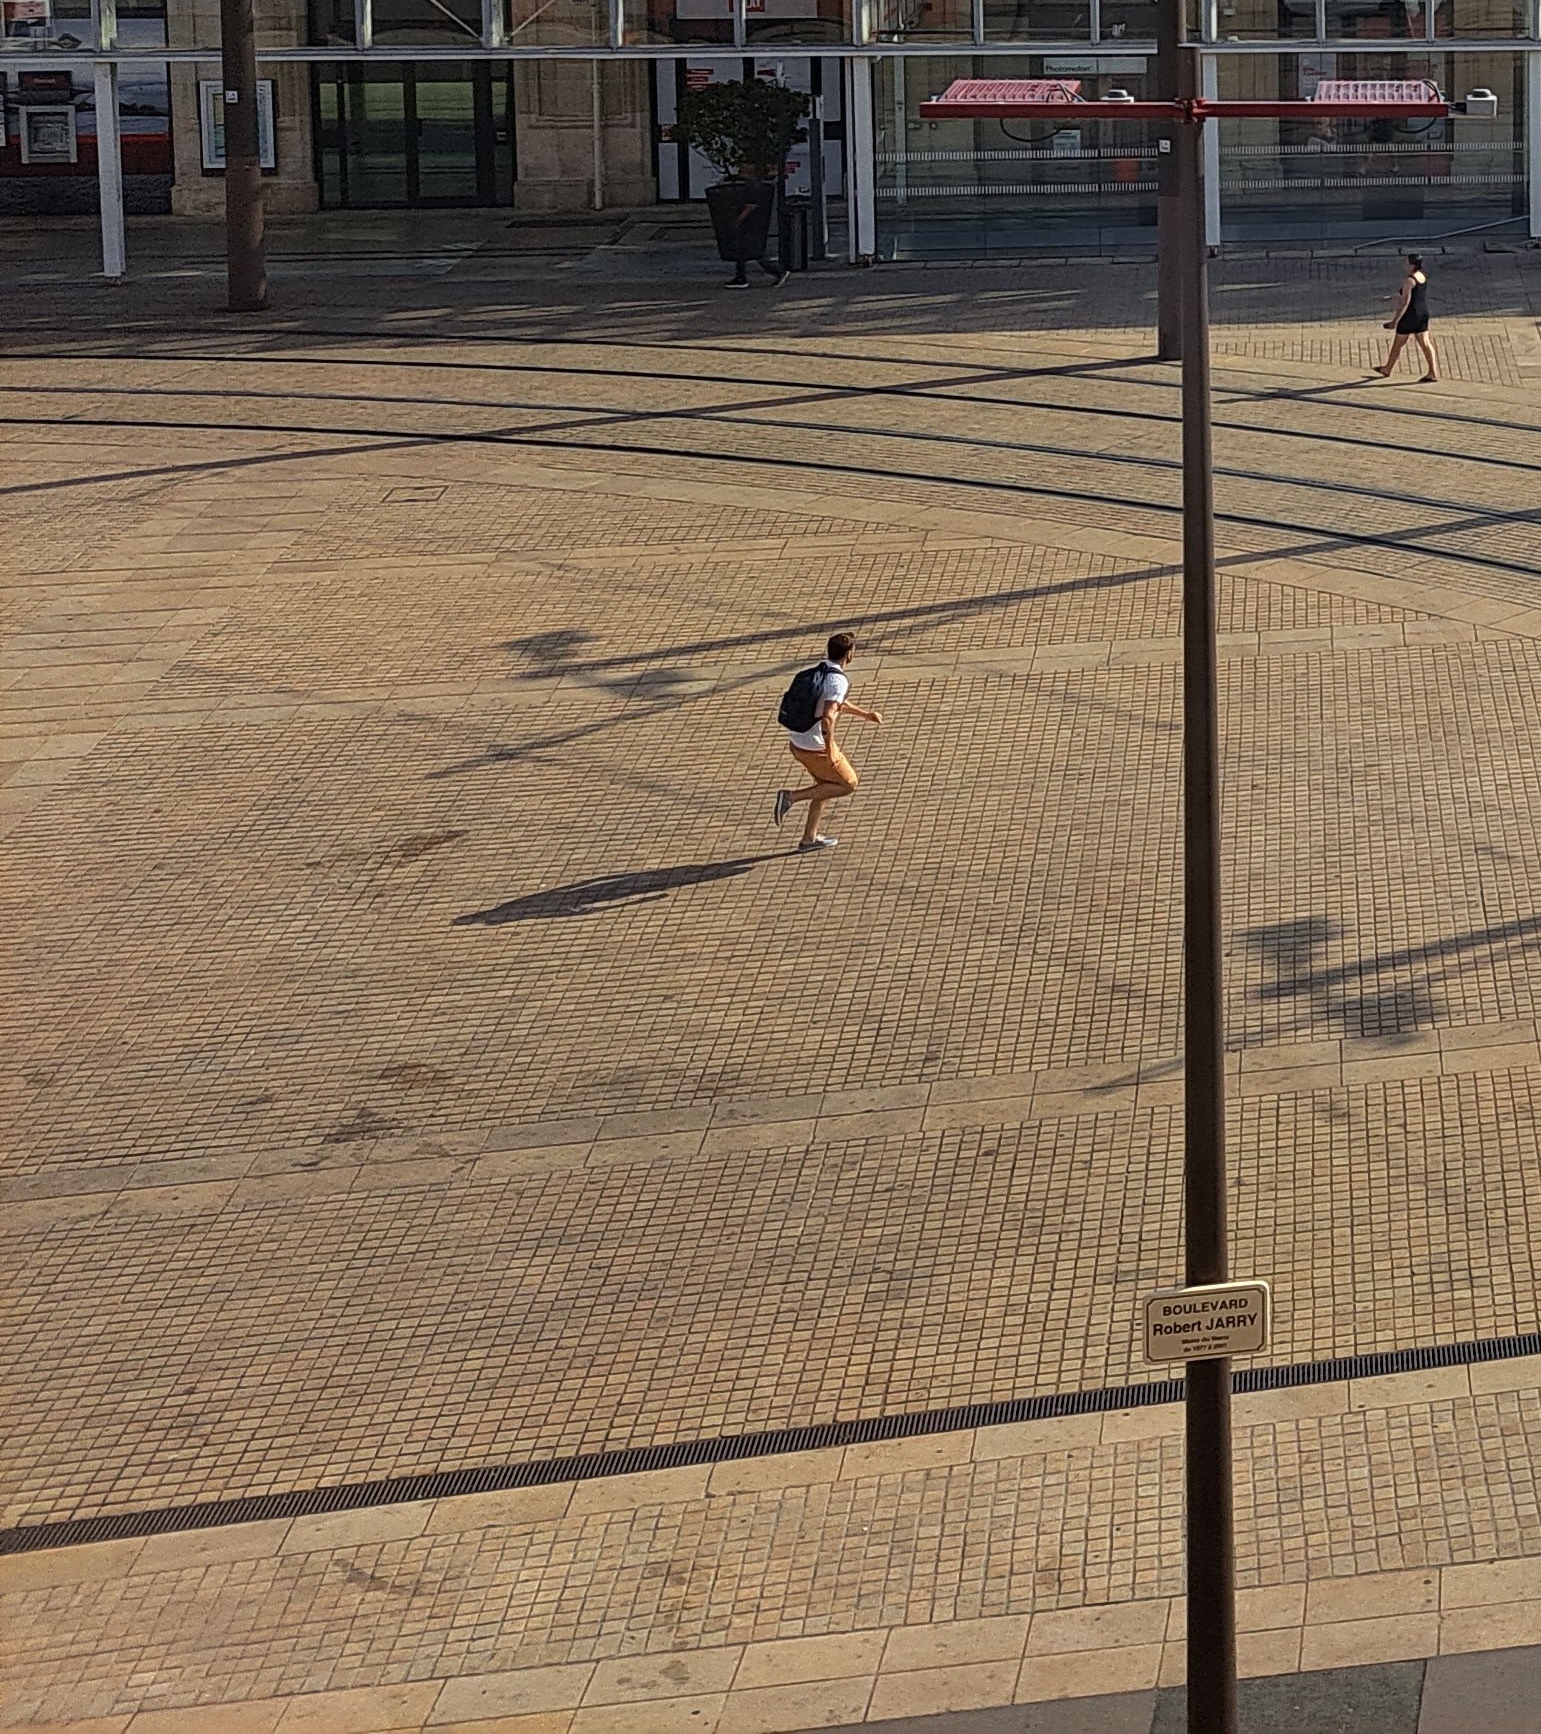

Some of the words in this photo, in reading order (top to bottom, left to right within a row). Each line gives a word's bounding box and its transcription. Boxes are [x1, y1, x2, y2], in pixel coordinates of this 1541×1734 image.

[1162, 1298, 1249, 1317] BOULEVARD
[1153, 1320, 1202, 1337] Robert
[1205, 1312, 1258, 1331] JARRY
